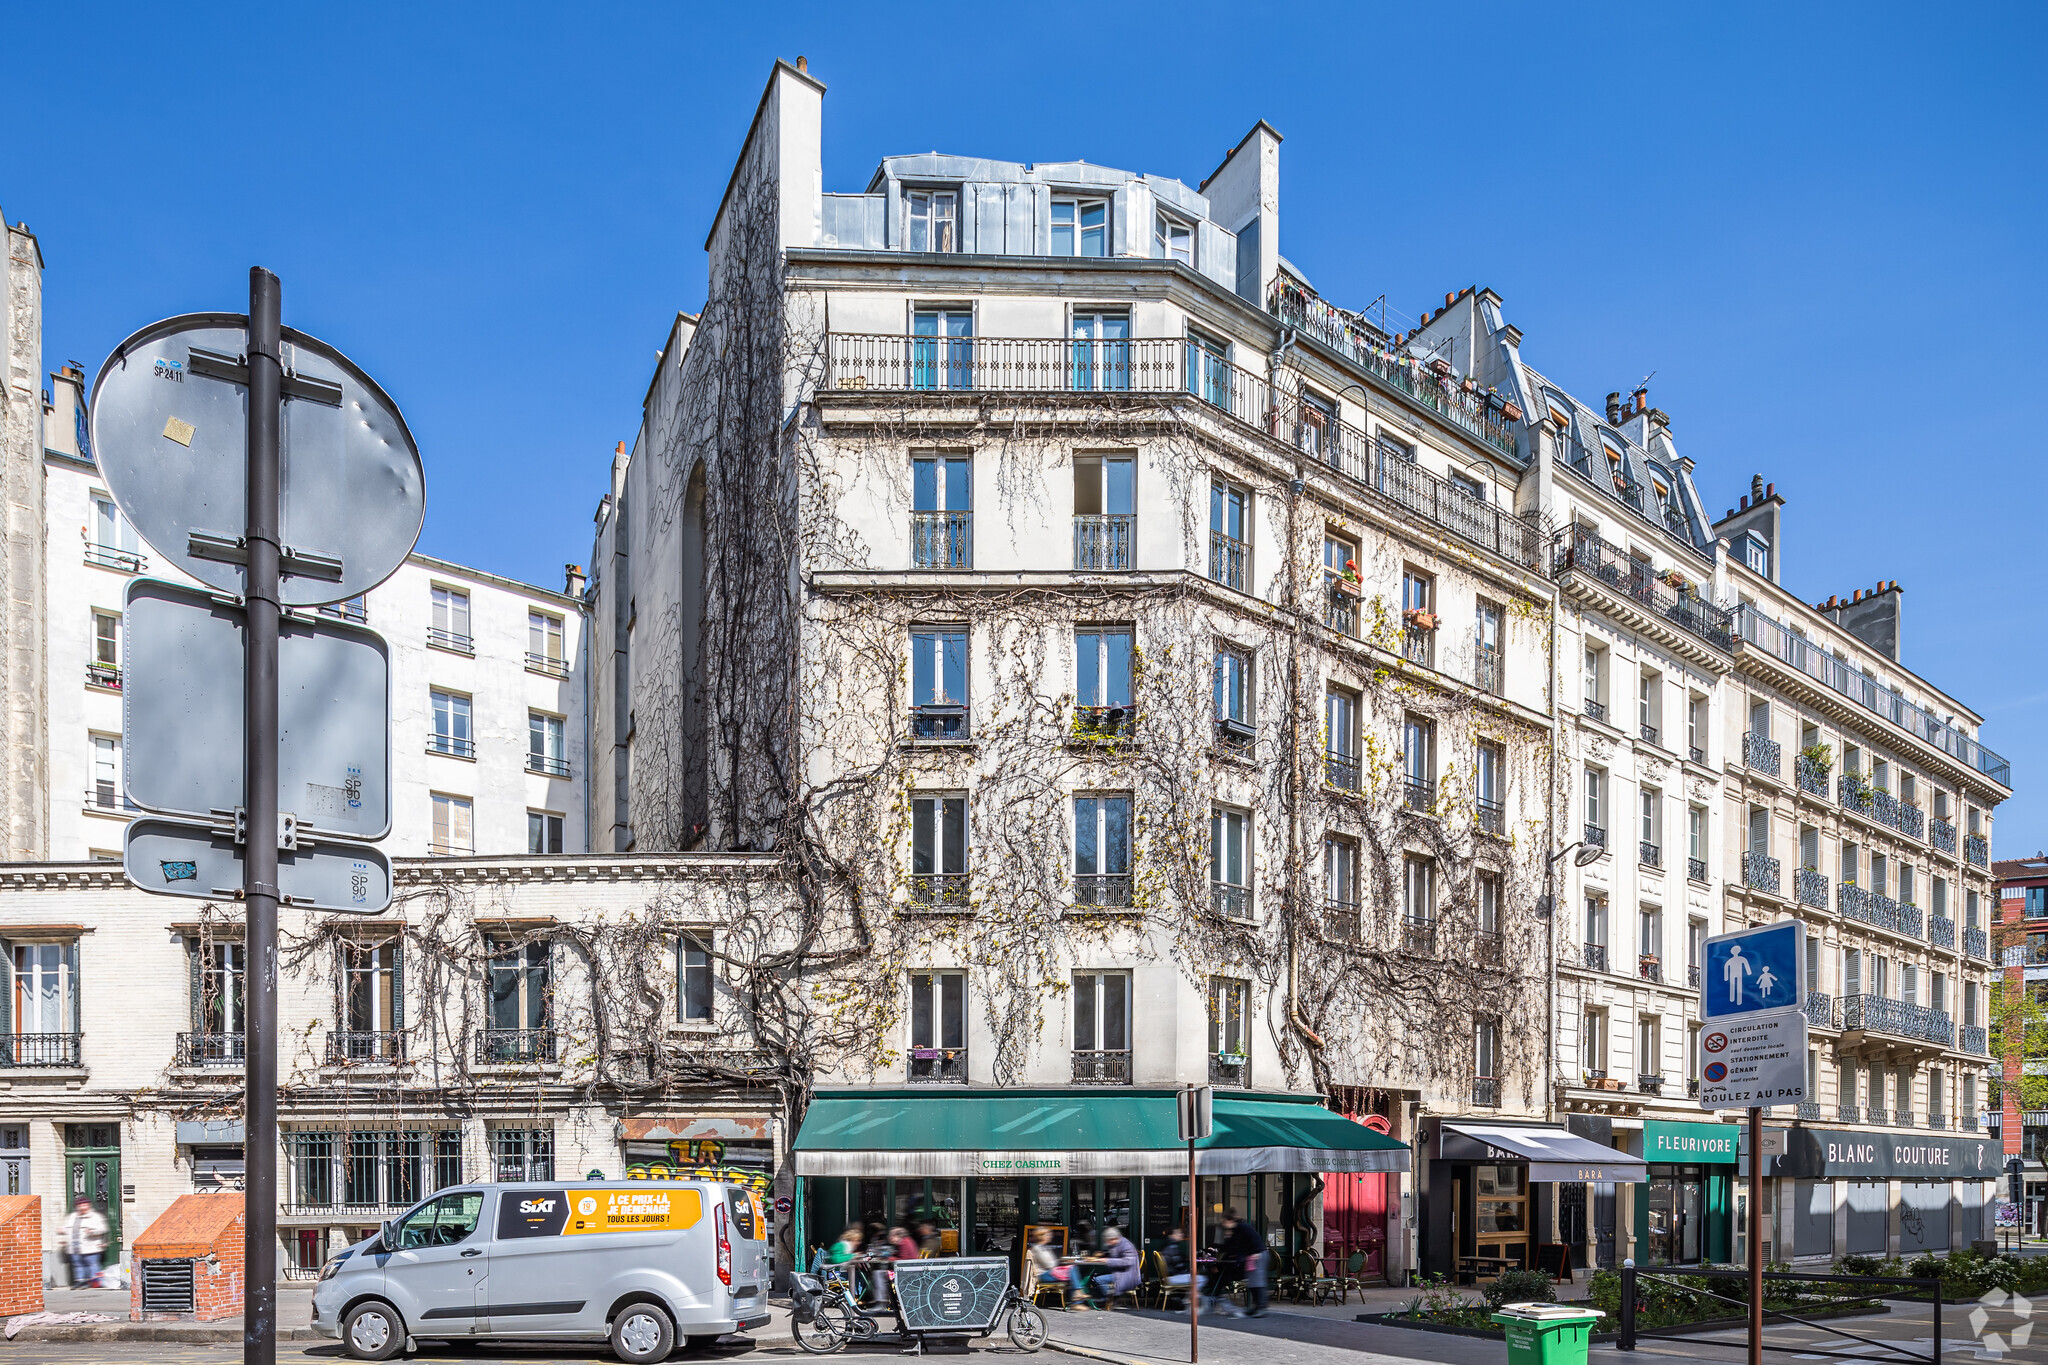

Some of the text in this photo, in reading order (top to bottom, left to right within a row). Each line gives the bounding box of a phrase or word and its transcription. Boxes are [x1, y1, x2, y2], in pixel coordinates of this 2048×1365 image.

[345, 779, 361, 790] SP
[347, 790, 360, 800] 90
[351, 875, 368, 886] SP
[352, 886, 366, 896] 90
[1730, 1022, 1779, 1034] CIRCULATION
[1730, 1034, 1768, 1044] INTERDITE
[1730, 1052, 1789, 1063] STATIONNEMENT
[1730, 1066, 1758, 1074] GÊNANT
[1703, 1088, 1802, 1103] ROULEZ AU PAS
[1658, 1135, 1731, 1152] FLEURIVORE
[1828, 1143, 1950, 1165] BLANC COUTURE
[982, 1160, 1061, 1168] CHEZ CASIMIR
[1311, 1157, 1361, 1166] CHEZ CASIMIR
[617, 1195, 630, 1205] CE
[520, 1198, 556, 1213] SIXT
[607, 1205, 619, 1215] JE
[607, 1215, 625, 1223] TOUS
[627, 1215, 639, 1223] LES
